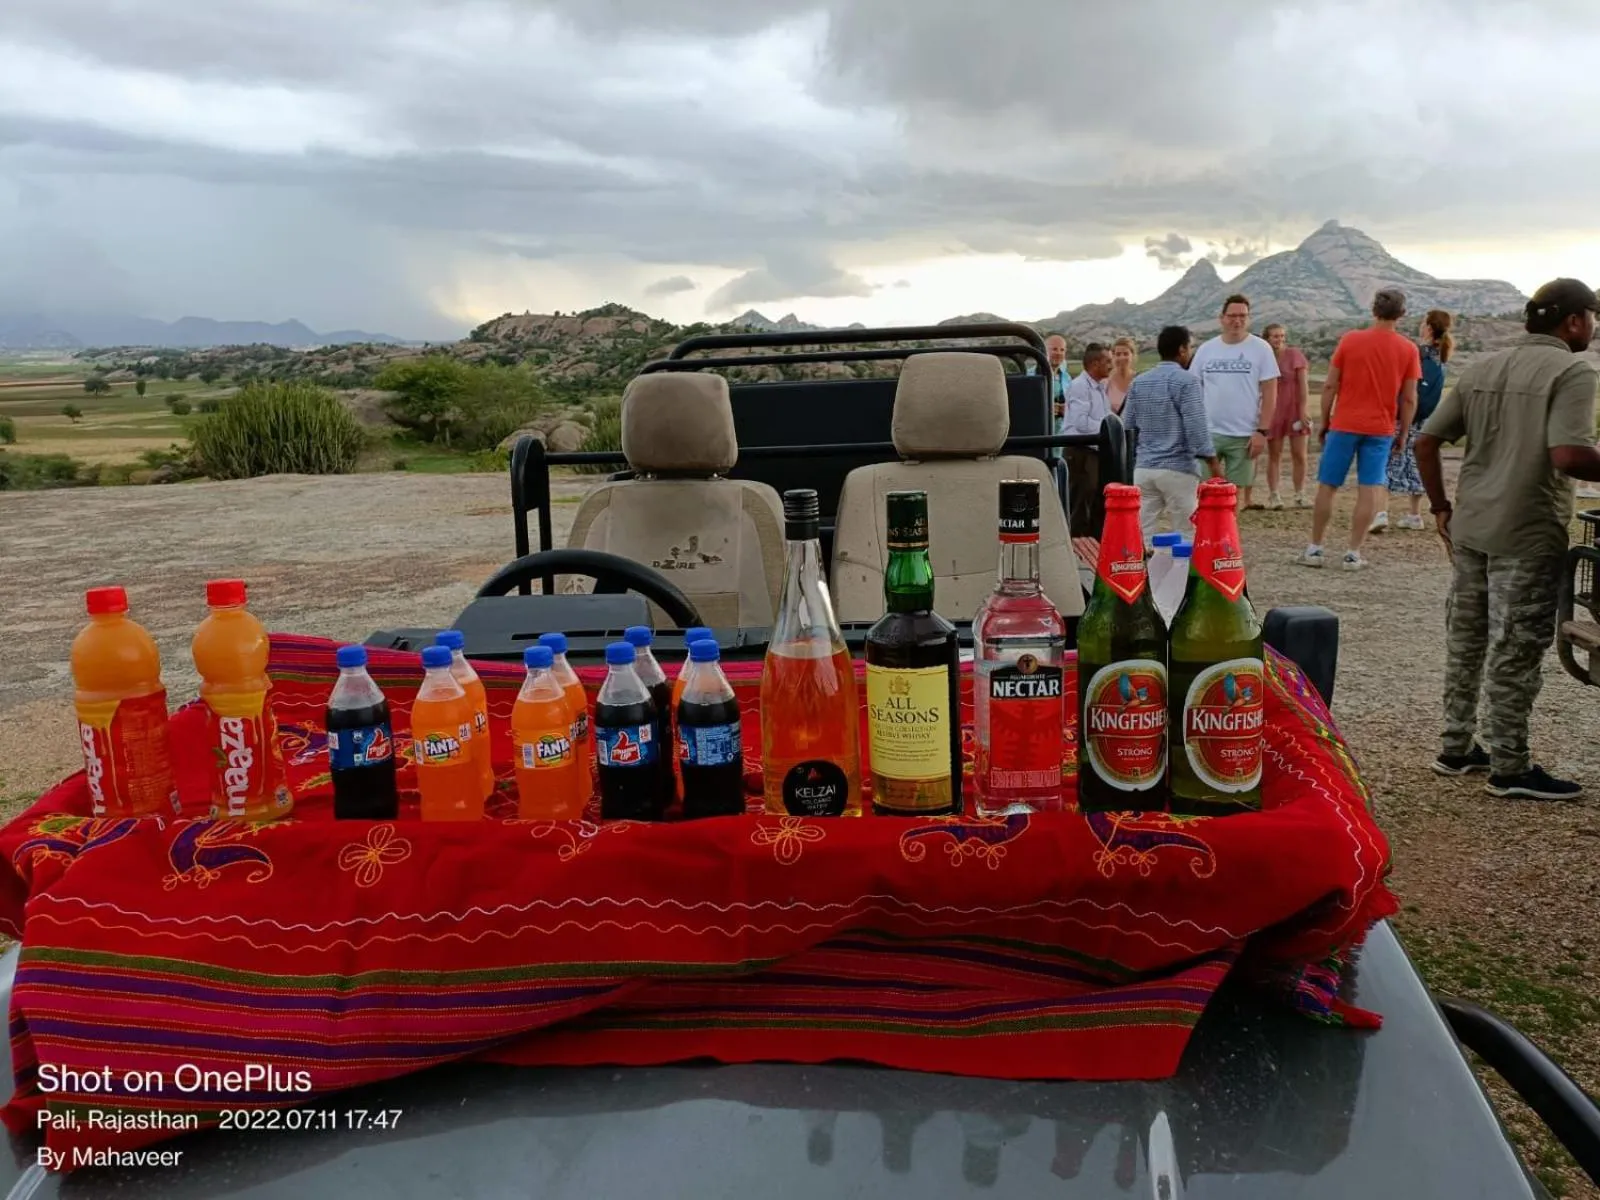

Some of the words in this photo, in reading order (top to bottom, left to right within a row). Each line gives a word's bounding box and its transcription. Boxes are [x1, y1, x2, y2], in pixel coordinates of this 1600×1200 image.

[999, 519, 1025, 528] ECTAR
[993, 679, 1060, 697] NECTAR
[885, 697, 917, 710] ALL
[870, 703, 939, 724] SEASONS
[424, 737, 460, 755] FANTA
[537, 737, 570, 757] FANTA
[1117, 746, 1153, 757] STRONG
[1220, 747, 1255, 758] STRONG
[220, 717, 254, 817] maaza
[795, 784, 836, 798] KELZAI
